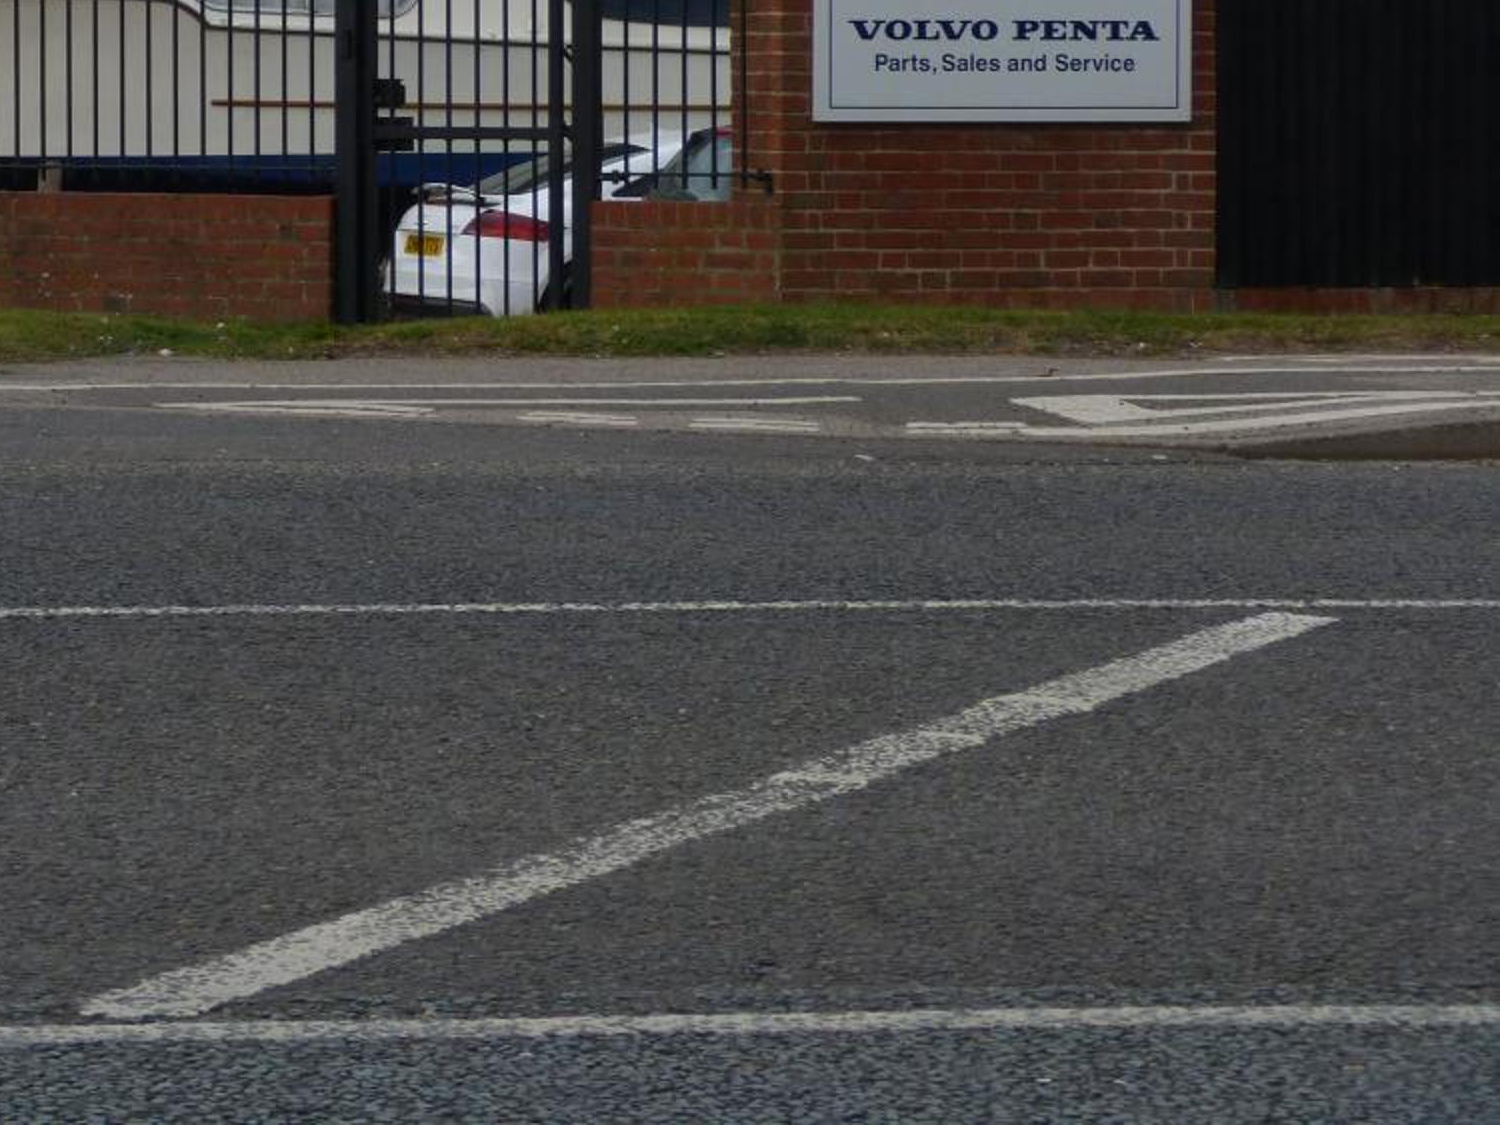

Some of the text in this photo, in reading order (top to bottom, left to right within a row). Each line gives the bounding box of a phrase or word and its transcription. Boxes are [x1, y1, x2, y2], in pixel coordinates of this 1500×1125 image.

[849, 20, 1159, 41] VOLVO PENTA
[874, 53, 1134, 74] Parts, Sales and Service
